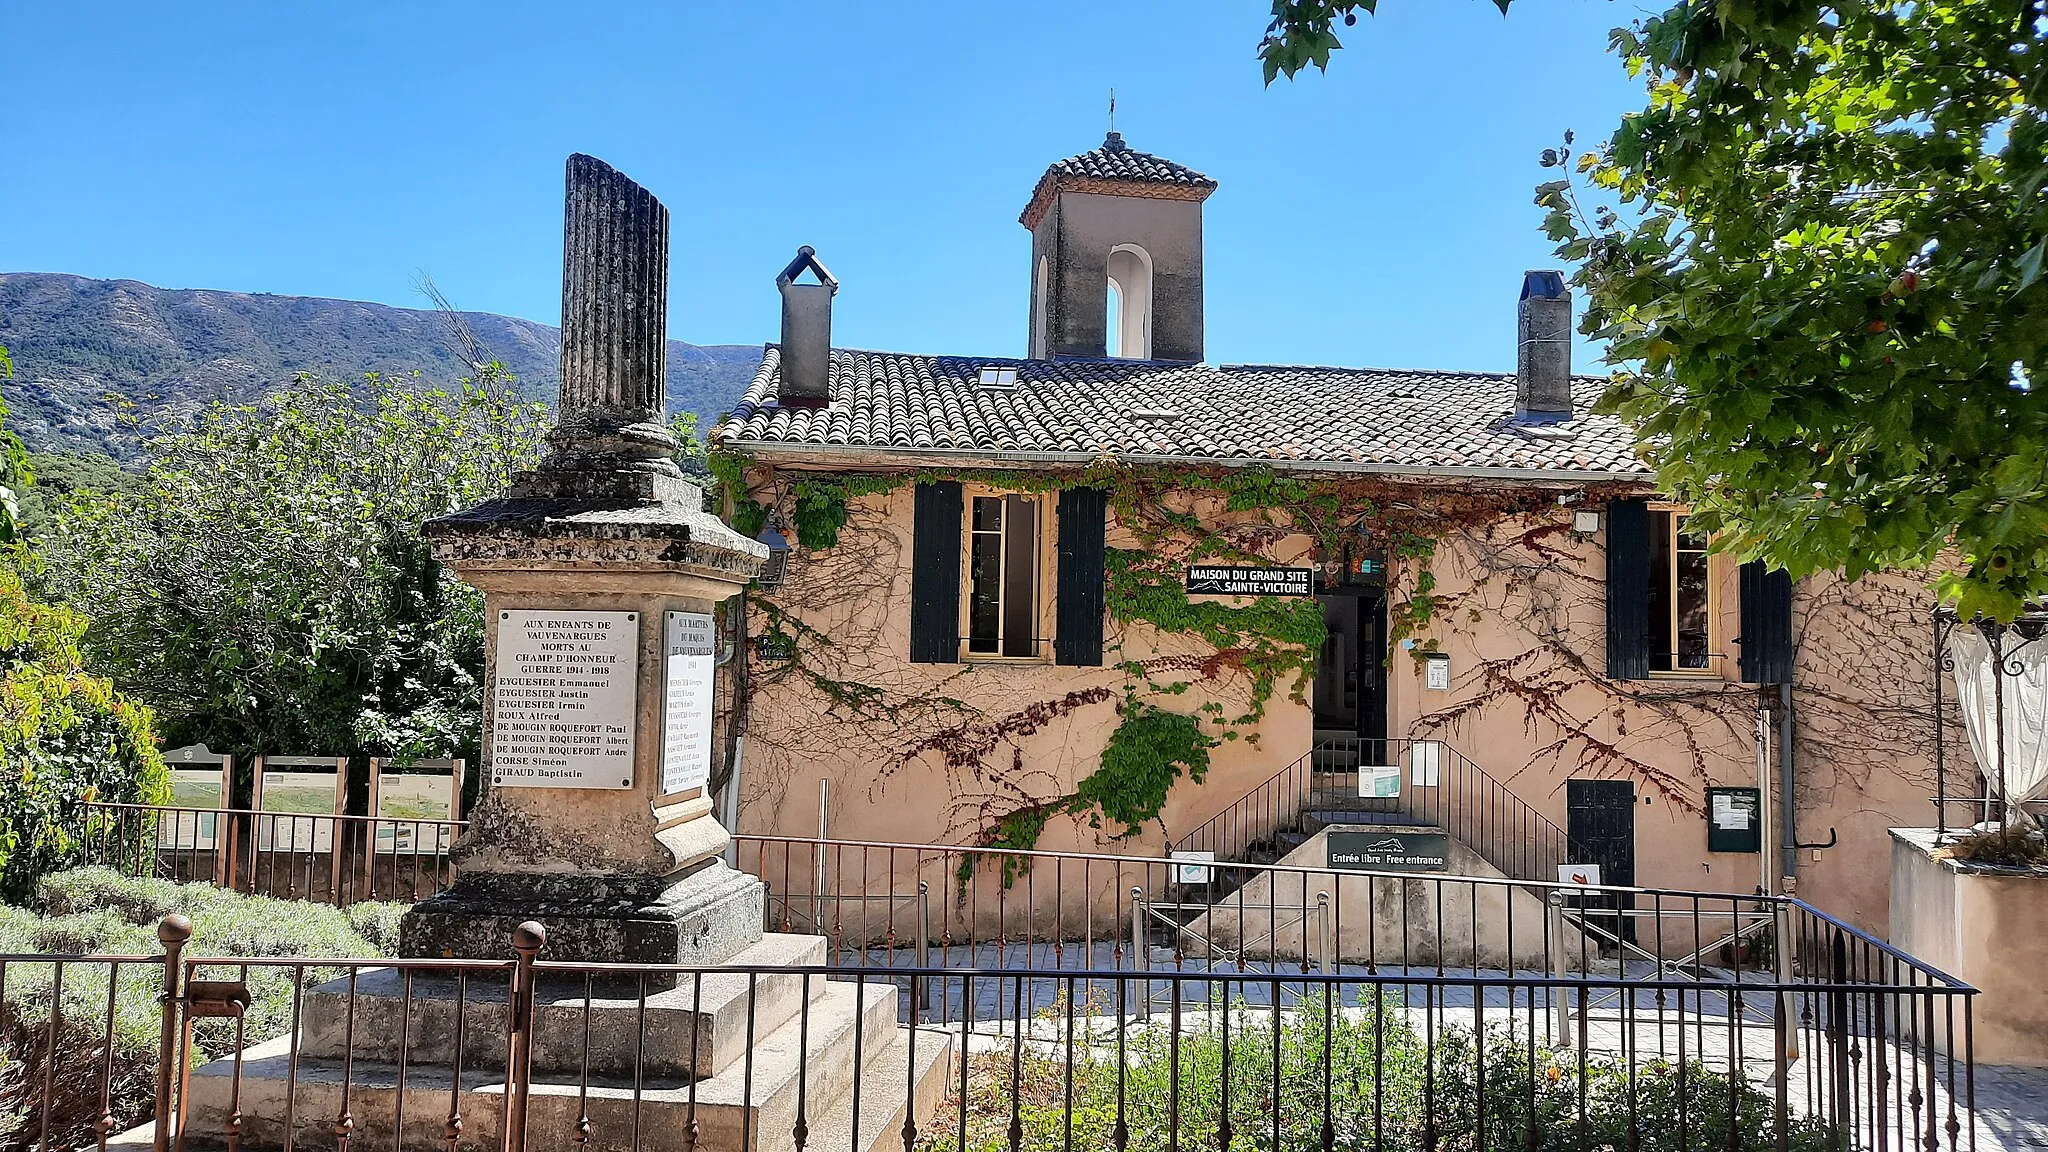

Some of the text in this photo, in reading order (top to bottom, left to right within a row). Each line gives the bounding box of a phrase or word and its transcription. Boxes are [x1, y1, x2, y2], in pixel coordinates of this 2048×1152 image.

[1190, 569, 1308, 582] MAISON DU GRAND SITE
[1224, 582, 1308, 594] SAINTE-VICTOIRE
[524, 620, 611, 630] AUX ENFANTS DE
[527, 632, 607, 640] VAUVENARGUES
[540, 643, 592, 652] MORTS AU
[516, 654, 616, 664] CHAMP D'HONNEUR
[521, 665, 562, 674] GUERRE
[566, 666, 583, 674] 1914
[591, 666, 610, 674] 1918
[500, 678, 609, 688] EYGUESIER Emmanuel
[500, 689, 588, 698] EYGUESIER Justin
[498, 700, 585, 710] EYGUESIER Irmin
[498, 712, 560, 720] ROUX Alfred
[497, 723, 626, 733] DE MOUGIN ROQUEFORT Paul
[497, 734, 628, 745] DE MOUGIN ROQUEFORT Albert
[496, 745, 508, 753] DE
[511, 746, 546, 754] MOUGIN
[548, 746, 601, 756] ROQUEFORT
[496, 756, 567, 766] CORSE Siméon
[495, 768, 582, 778] GIRAUD Baptistin
[1332, 853, 1443, 865] Entrée libre Free entrance
